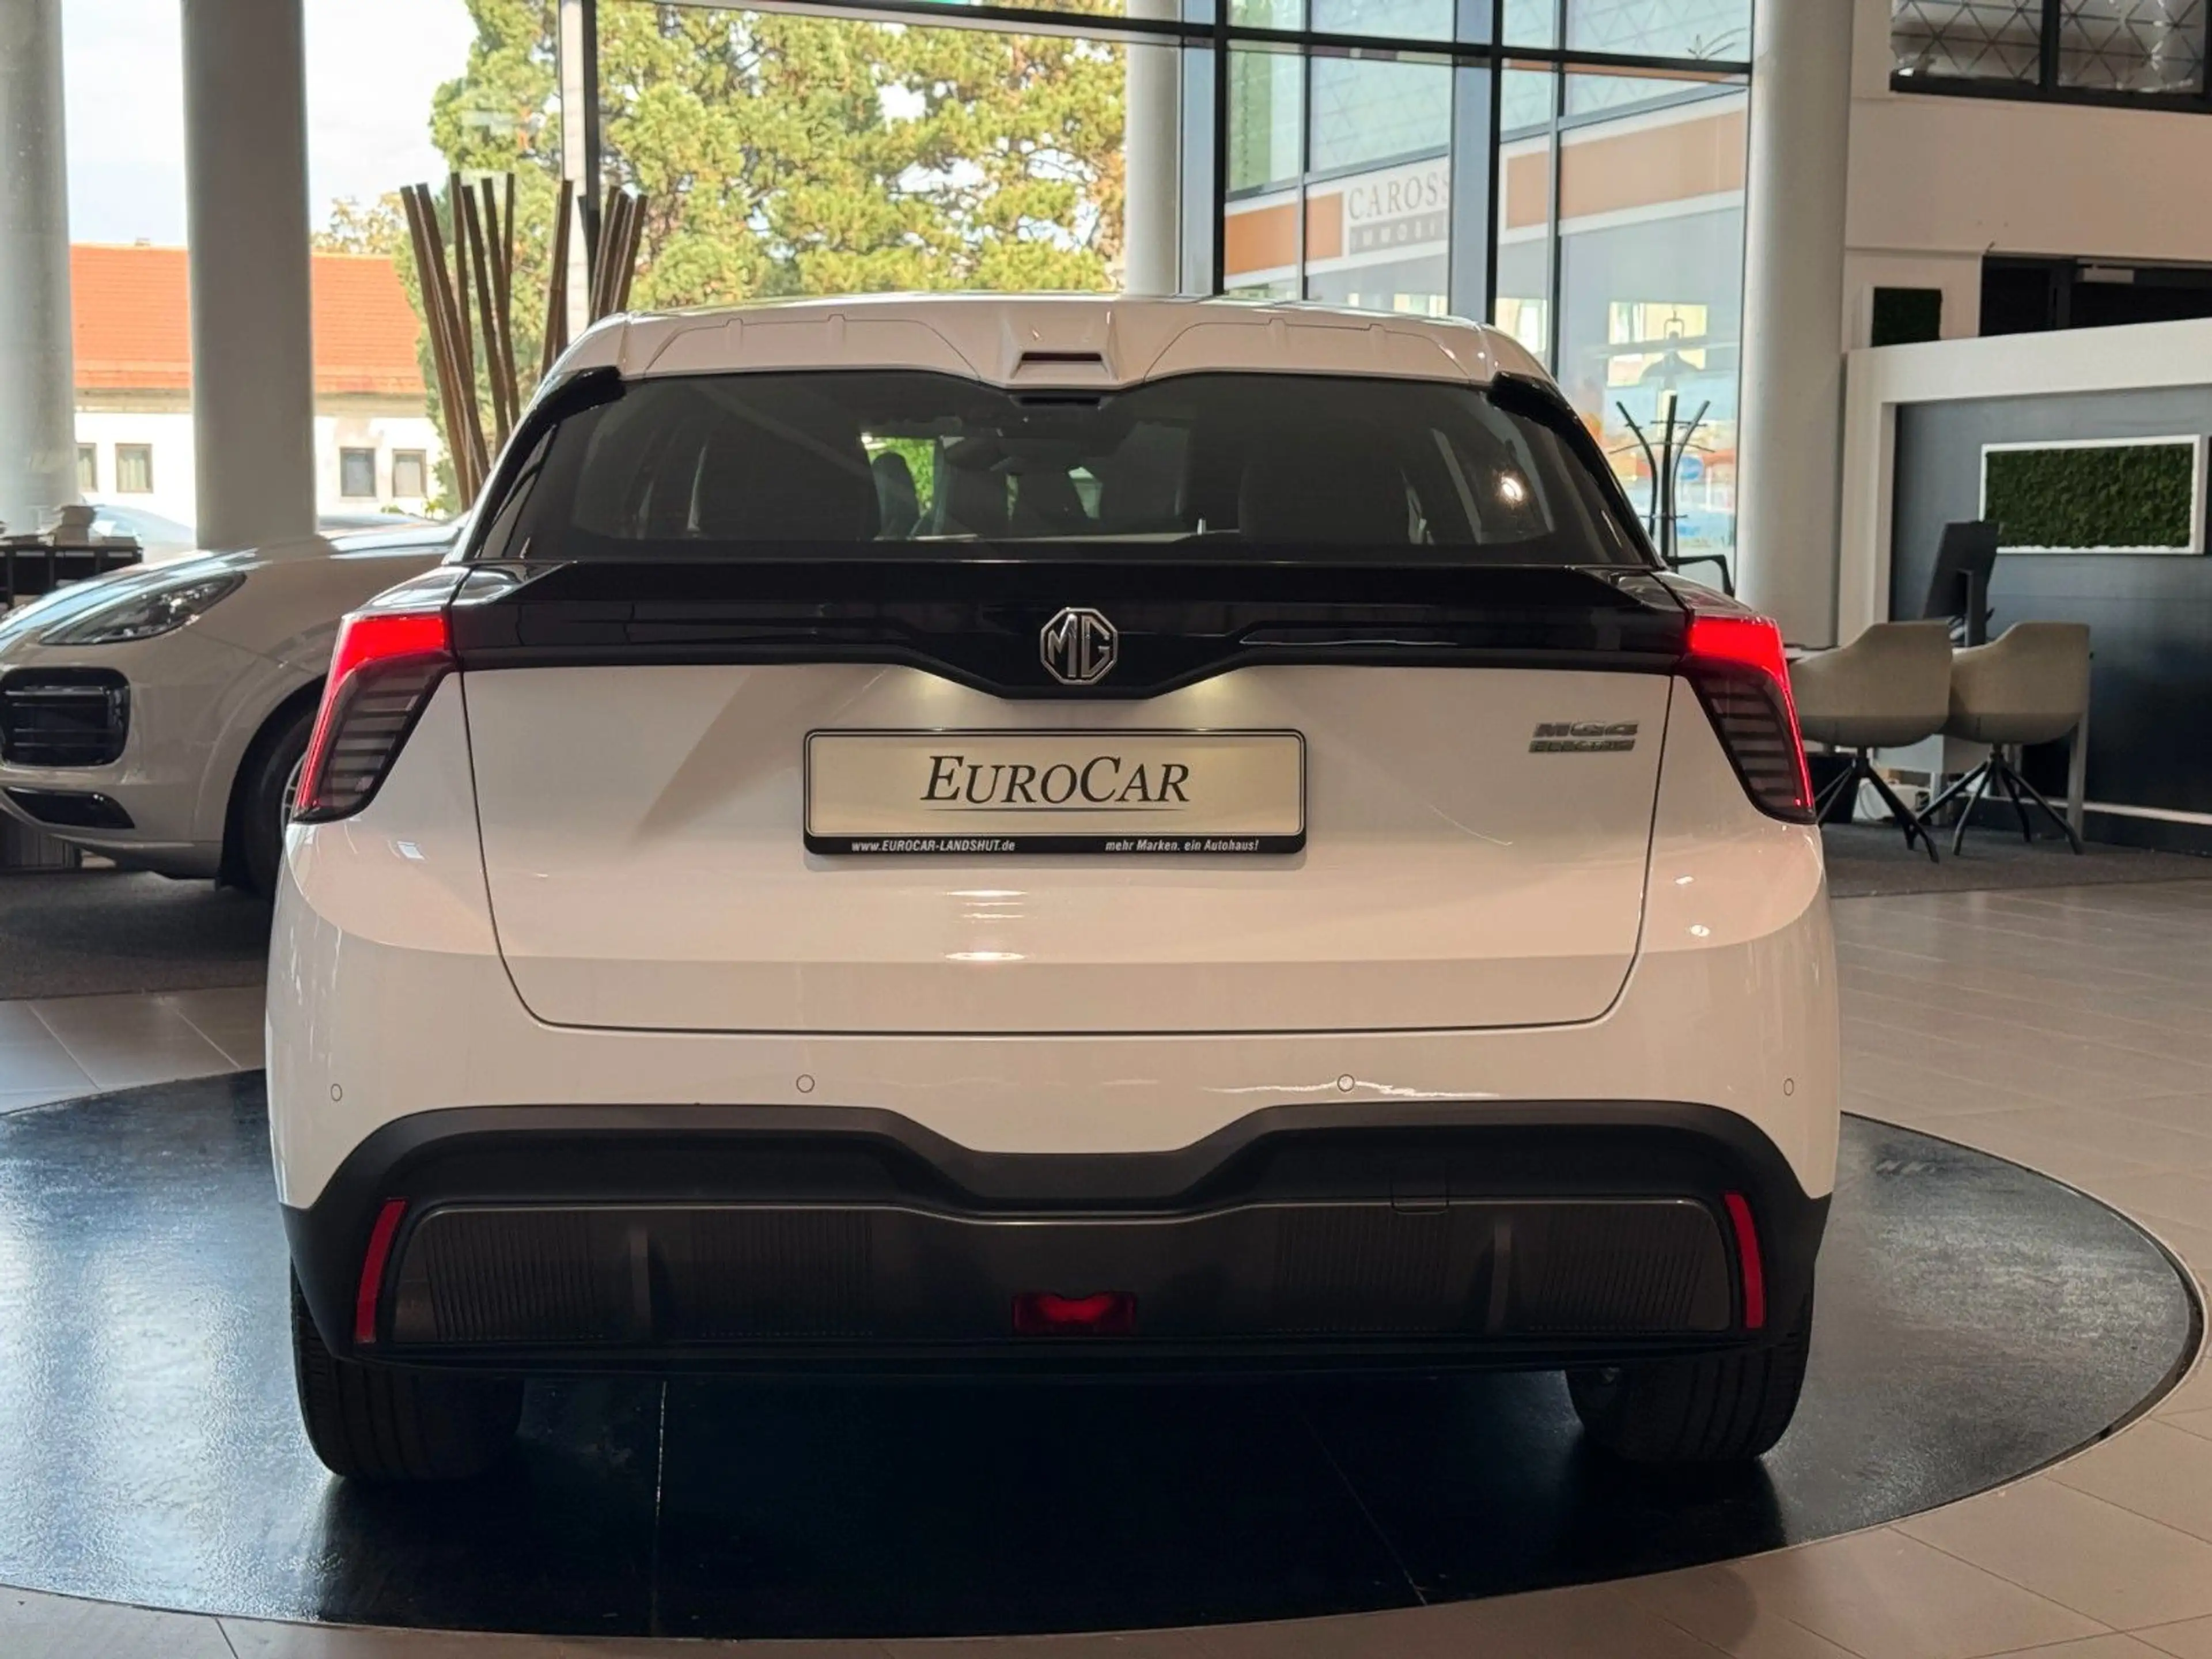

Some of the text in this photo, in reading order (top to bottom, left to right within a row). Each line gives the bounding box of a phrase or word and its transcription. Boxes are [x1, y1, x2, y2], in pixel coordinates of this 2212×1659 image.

[1047, 613, 1110, 678] MG
[851, 840, 1016, 851] www.EUROCAR-LANDSHUT.de
[1105, 839, 1134, 851] mehr
[1184, 839, 1201, 851] ein
[1203, 839, 1259, 851] Autohaus!
